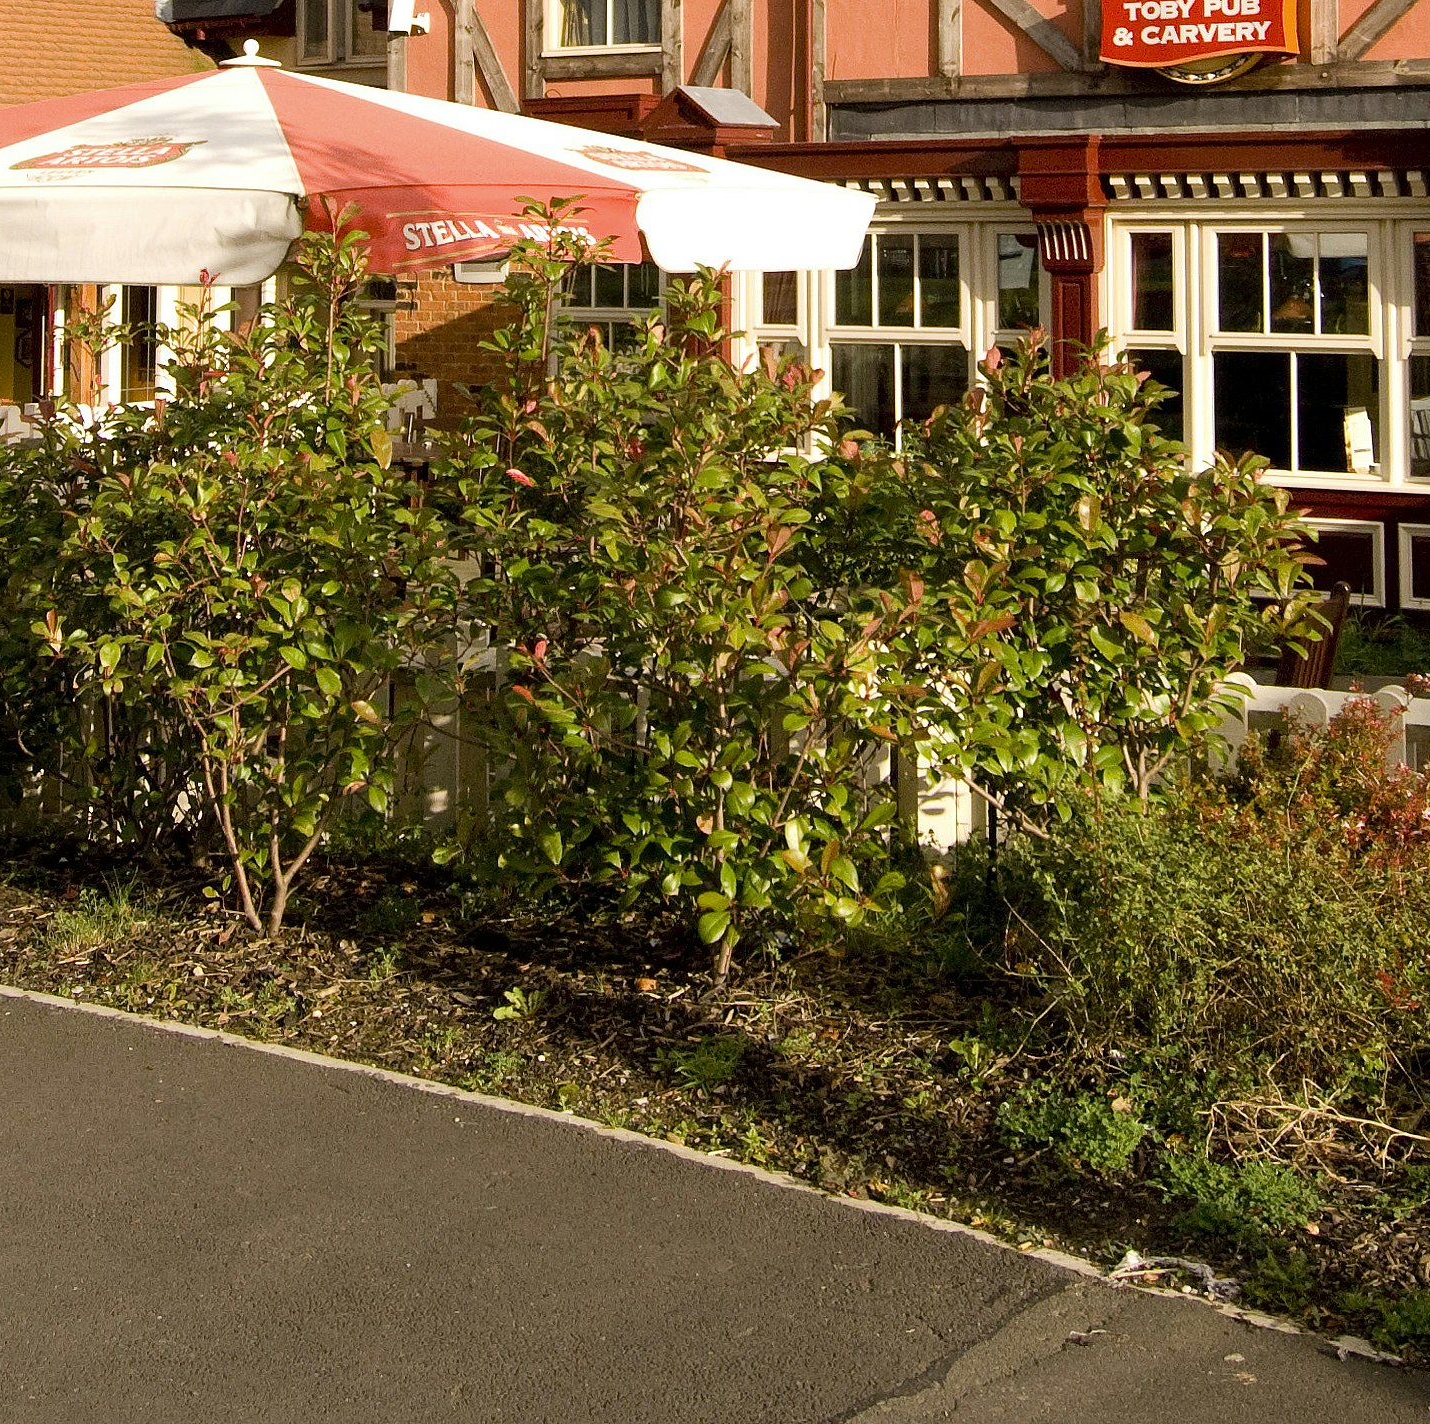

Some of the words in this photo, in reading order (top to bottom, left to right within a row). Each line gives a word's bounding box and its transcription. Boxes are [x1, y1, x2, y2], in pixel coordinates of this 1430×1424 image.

[1123, 0, 1195, 21] TOBY
[1112, 27, 1133, 46] &
[1140, 21, 1271, 45] CARVERY
[402, 219, 501, 250] STELLA
